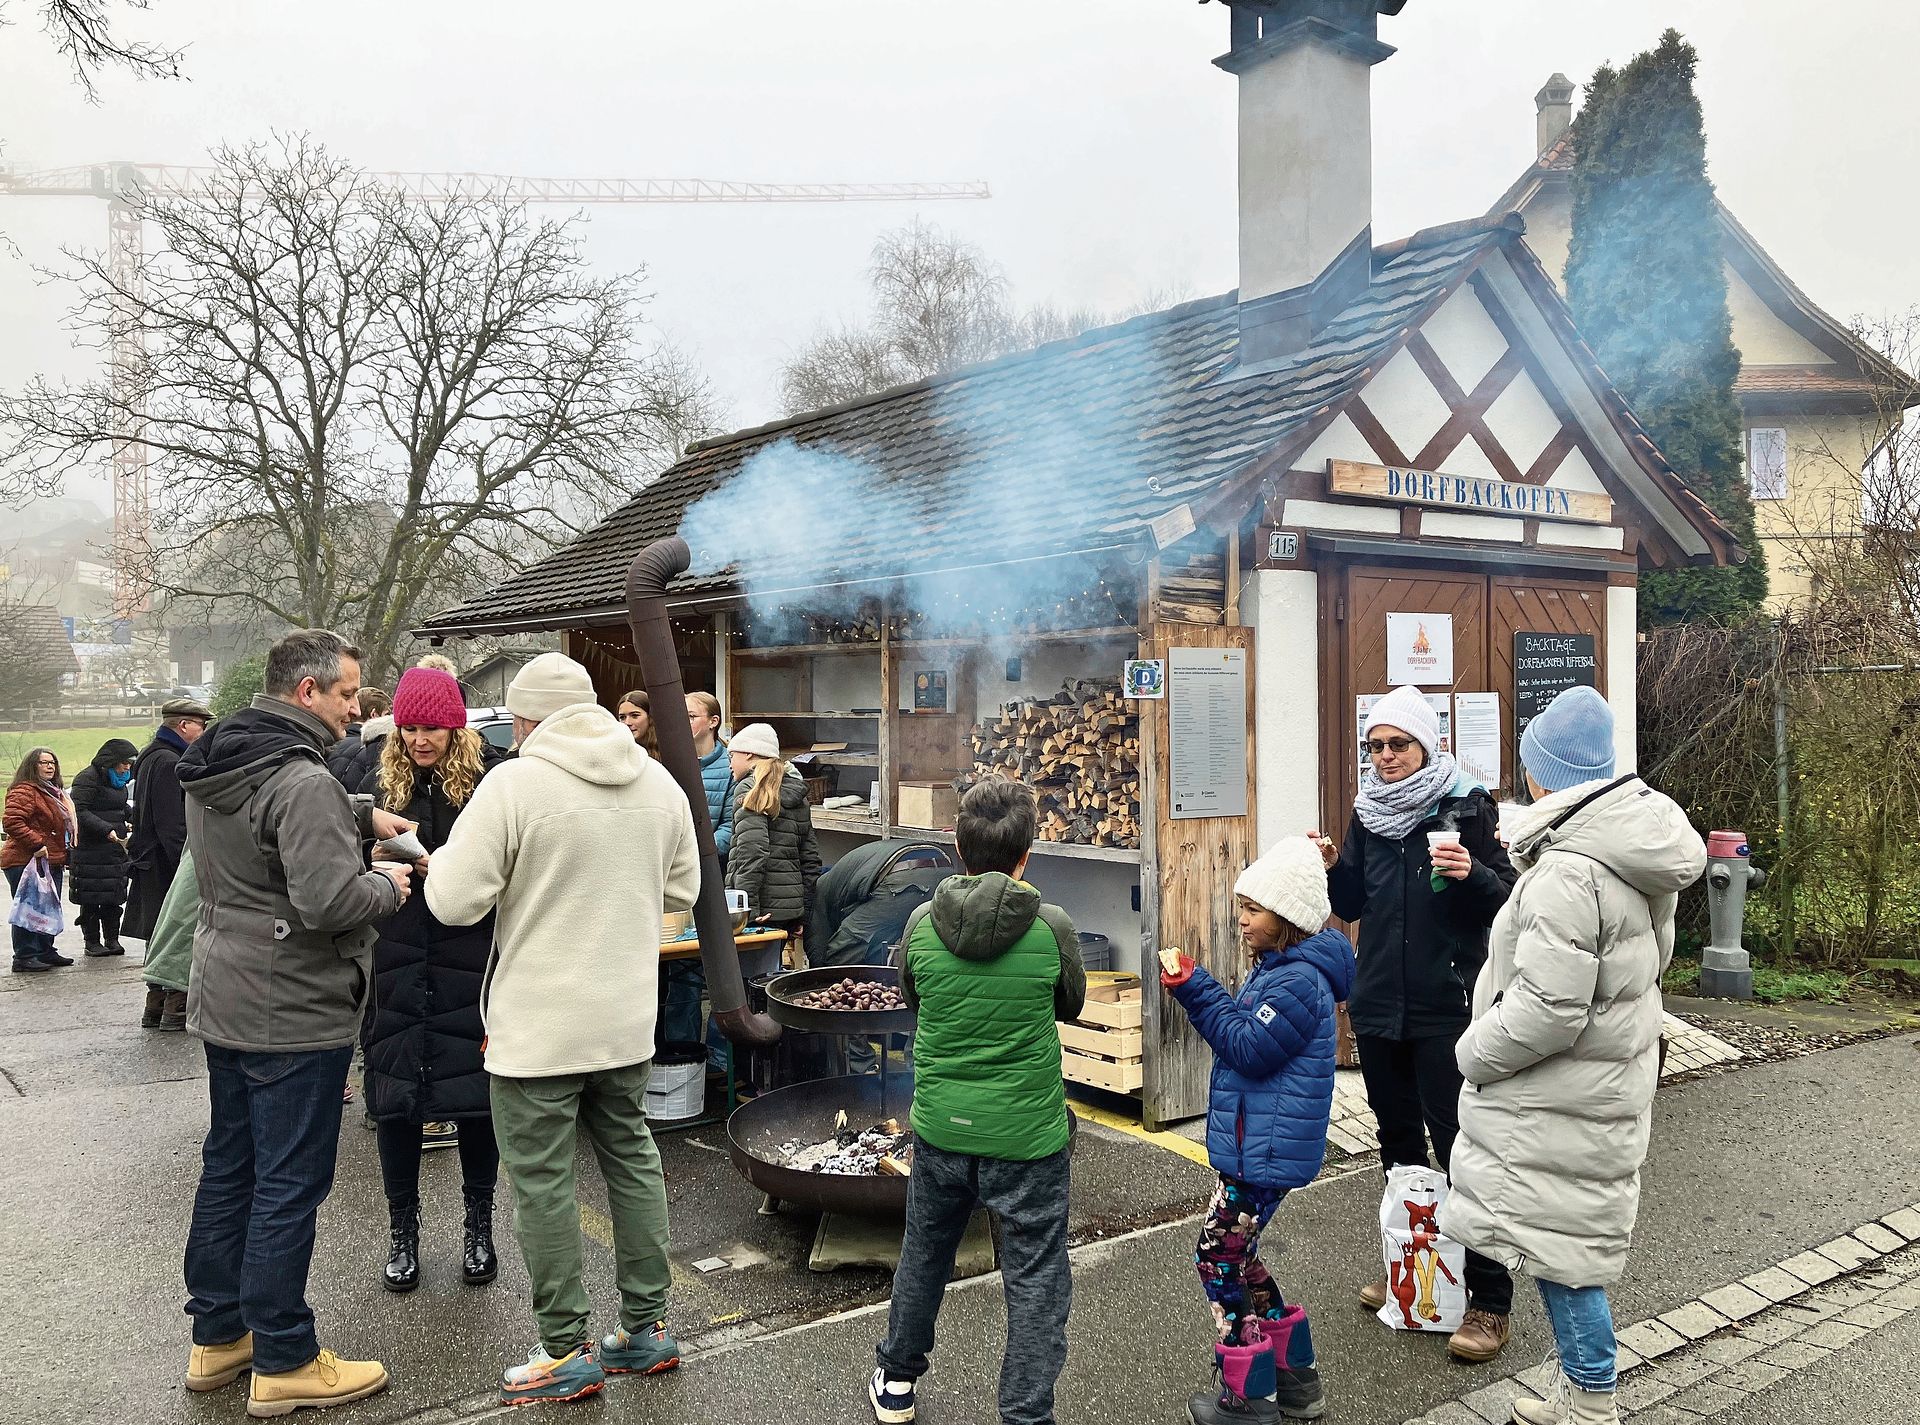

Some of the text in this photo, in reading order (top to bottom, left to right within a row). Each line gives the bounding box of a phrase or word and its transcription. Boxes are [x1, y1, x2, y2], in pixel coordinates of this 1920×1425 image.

[1387, 469, 1570, 515] DORFBACKOFEN
[1274, 537, 1295, 555] 115
[1525, 637, 1576, 655] BACKTAGE
[1518, 657, 1564, 670] DORFBACKOFEN
[1142, 671, 1151, 684] D
